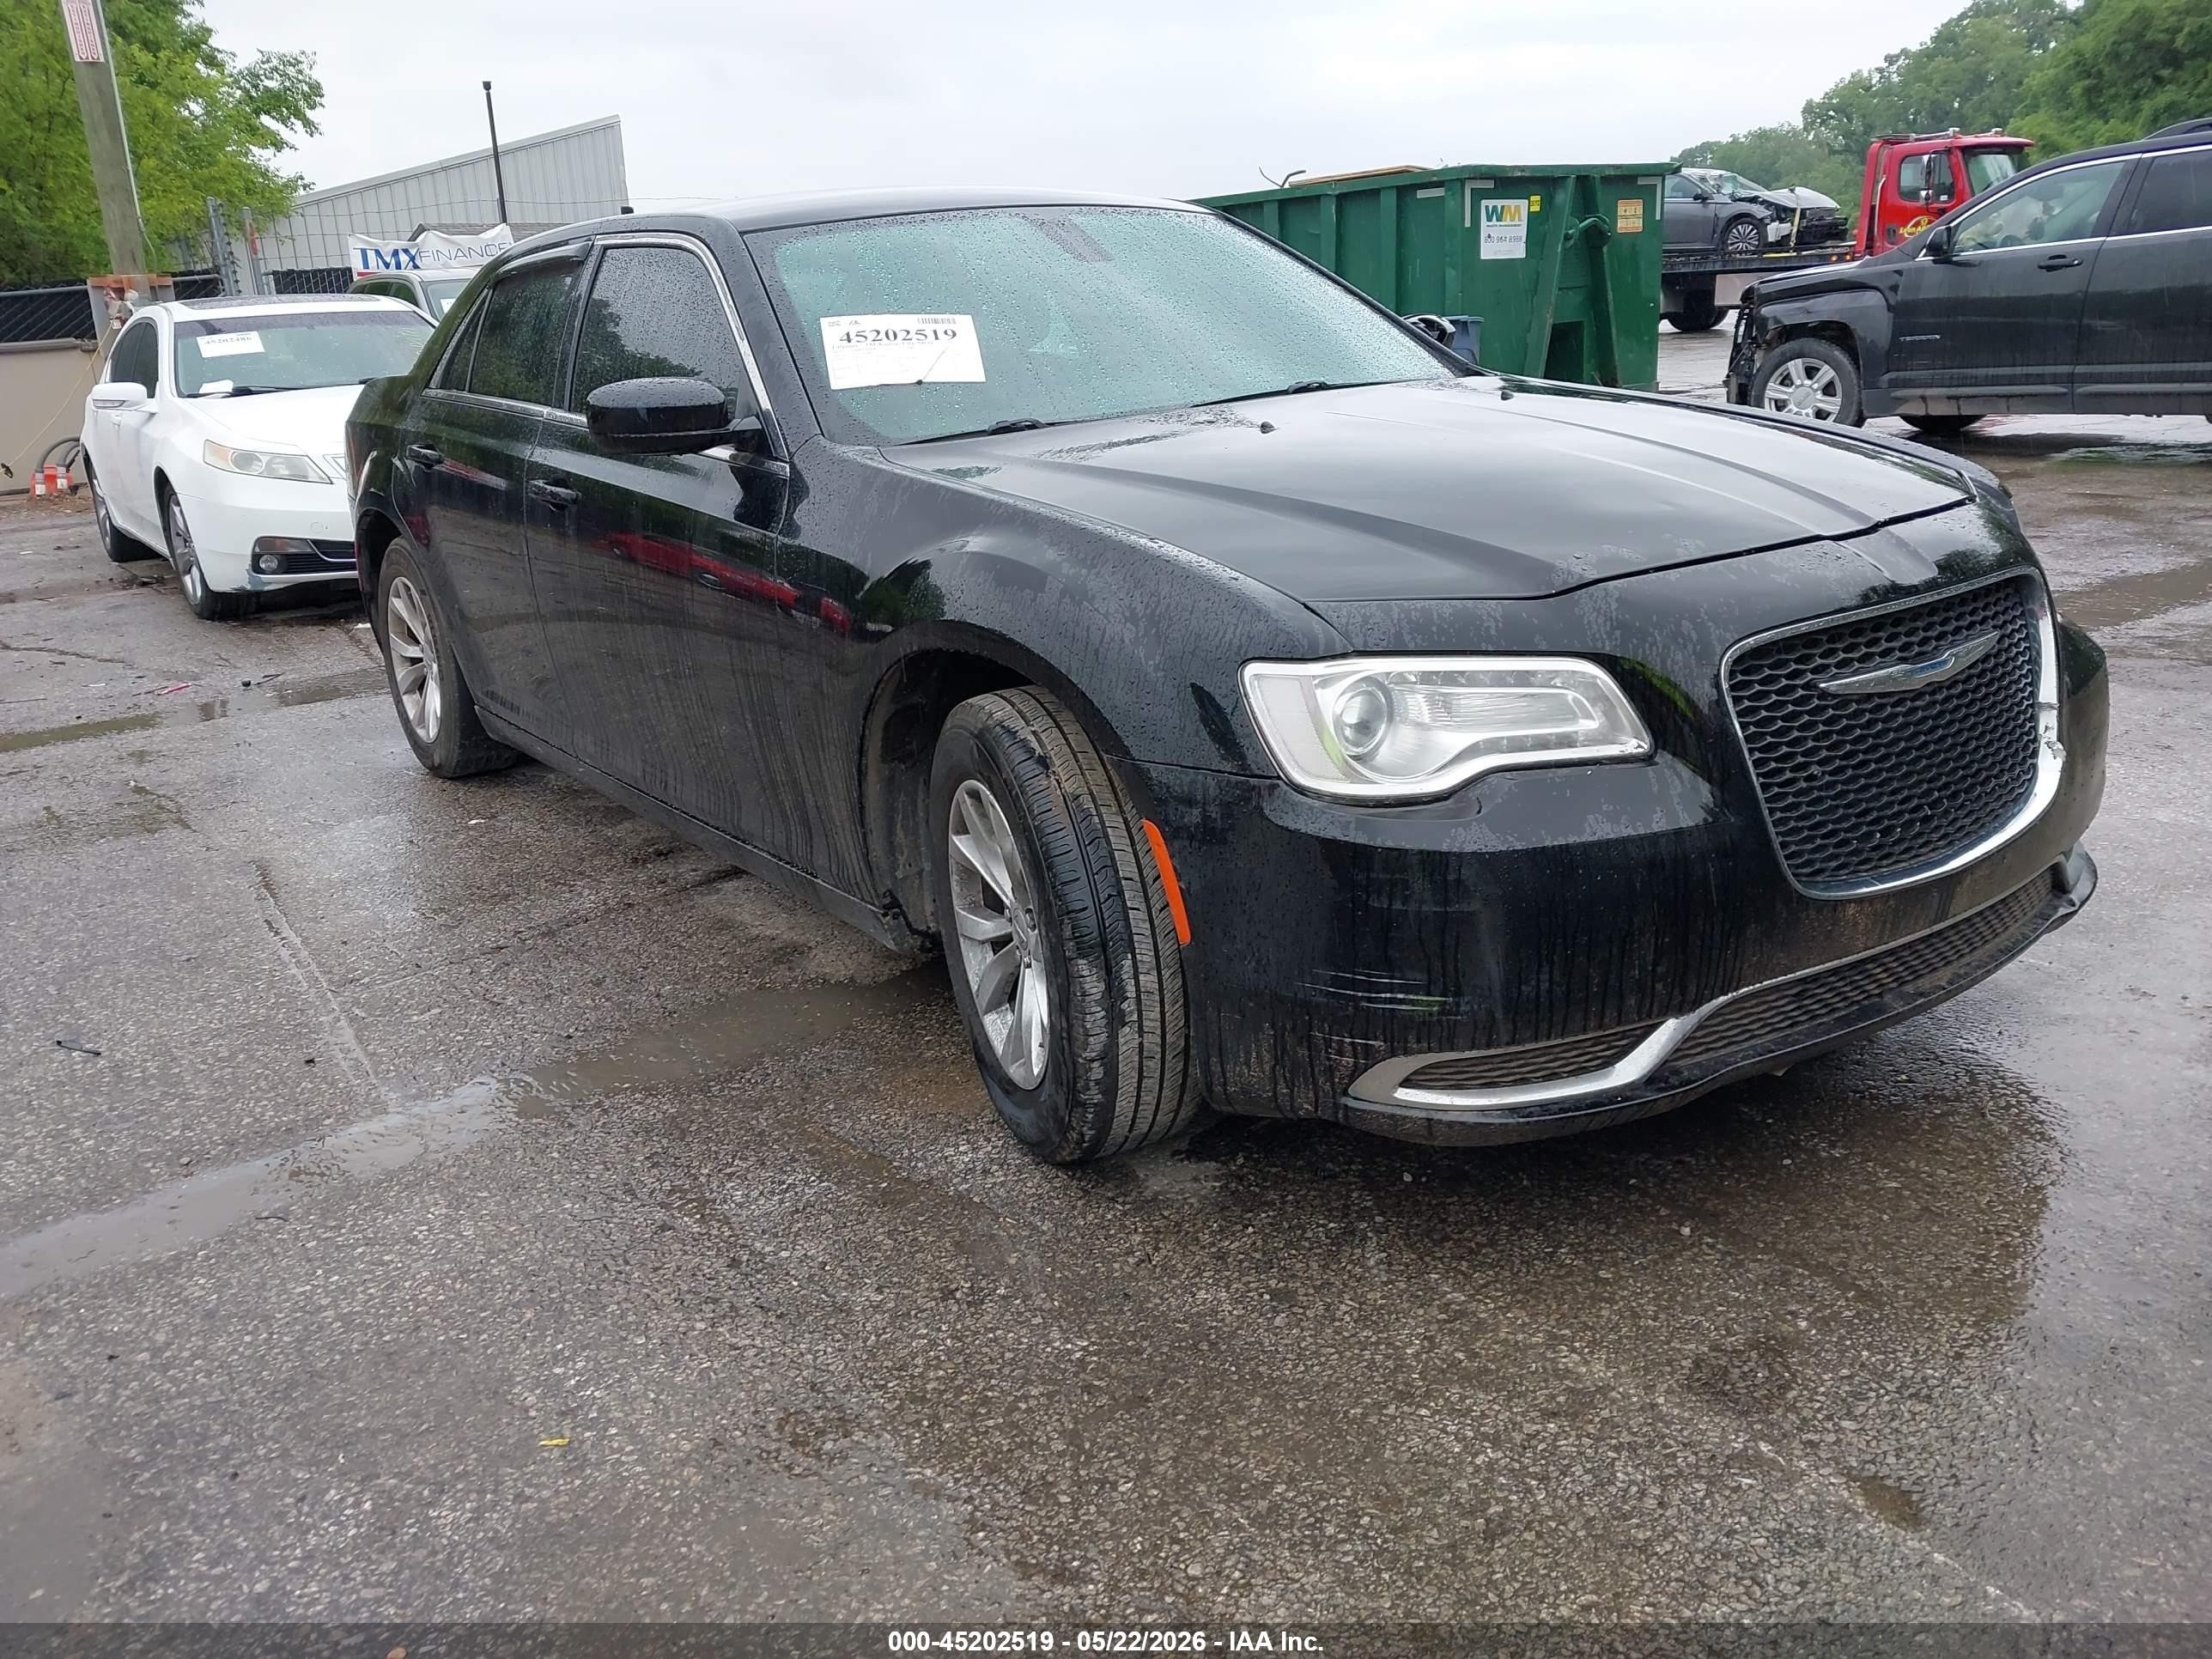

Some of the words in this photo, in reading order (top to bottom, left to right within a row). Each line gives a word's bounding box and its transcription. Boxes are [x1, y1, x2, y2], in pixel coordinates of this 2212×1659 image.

[1485, 204, 1522, 222] WM
[353, 247, 421, 270] TMX
[839, 328, 957, 343] 45202519
